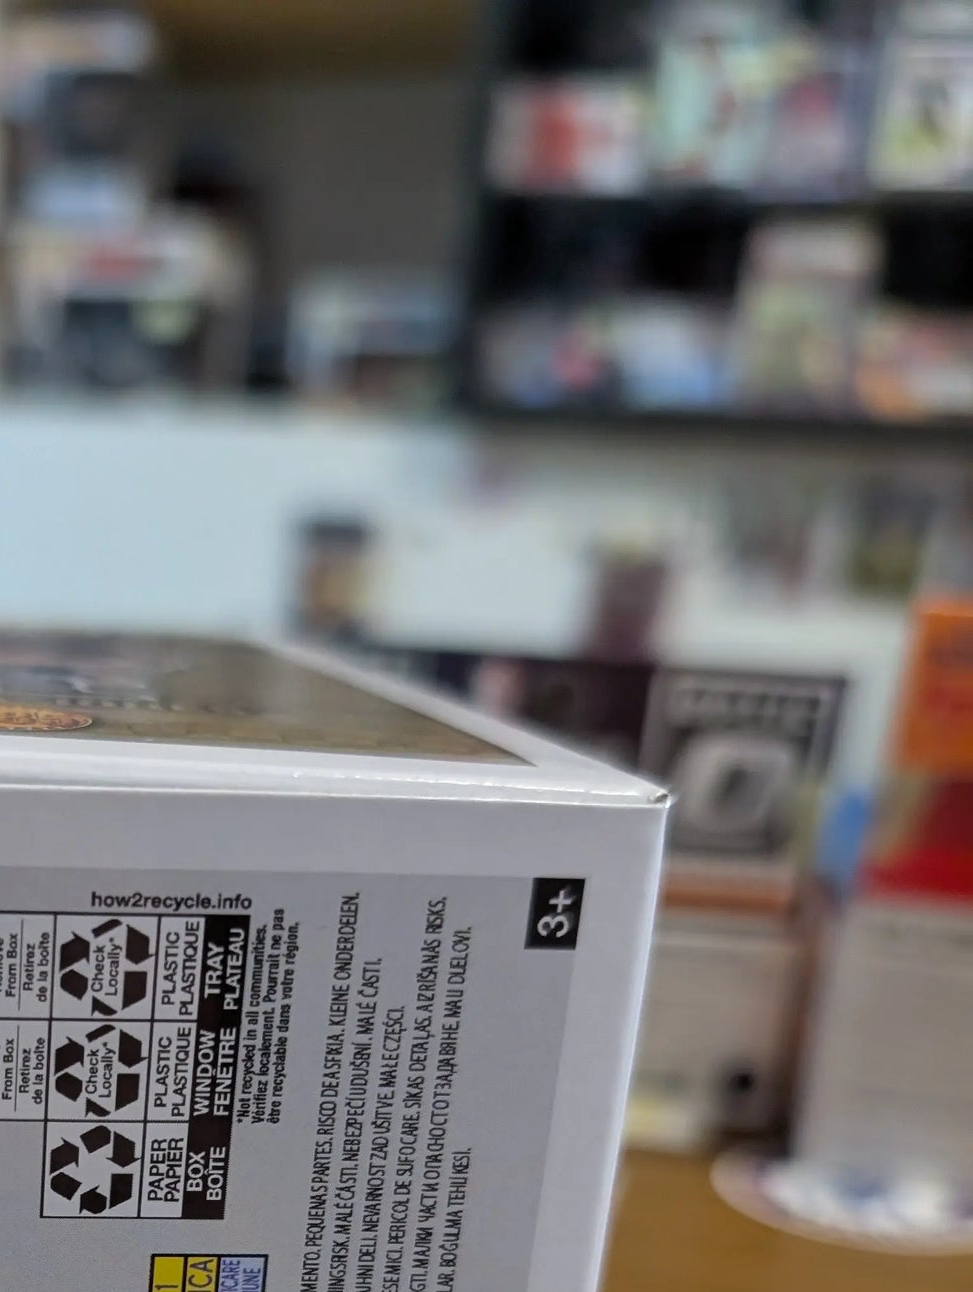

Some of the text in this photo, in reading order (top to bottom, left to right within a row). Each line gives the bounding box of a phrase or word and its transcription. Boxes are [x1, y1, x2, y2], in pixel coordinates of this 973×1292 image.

[90, 892, 252, 910] how2recycle.info
[272, 908, 286, 931] pas
[537, 888, 575, 938] 3+
[5, 933, 18, 998] From Box
[23, 943, 35, 991] Retirez
[91, 945, 105, 993] Check
[162, 932, 180, 1006] PLASTIC
[180, 920, 200, 1016] PLASTIQUE
[203, 942, 224, 999] TRAY
[223, 928, 245, 1010] PLATEAU
[248, 924, 267, 1007] communities.
[270, 935, 282, 951] ne
[265, 954, 280, 1003] Pourrait
[243, 1030, 257, 1041] in
[245, 1011, 259, 1025] all
[255, 1007, 275, 1077] localement.
[266, 922, 299, 1124] être recyclable dans votre région.
[2, 1038, 14, 1100] From Box
[19, 1048, 31, 1094] Retirez
[85, 1049, 99, 1095] Check
[154, 1036, 172, 1108] PLASTIC
[171, 1026, 191, 1117] PLASTIQUE
[193, 1029, 215, 1116] WINDOW
[212, 1027, 236, 1117] FENÊTRE
[239, 1044, 258, 1095] recycled
[147, 1139, 166, 1202] PAPER
[163, 1137, 184, 1203] PAPIER
[186, 1151, 205, 1193] BOX
[203, 1146, 226, 1201] BOÎTE
